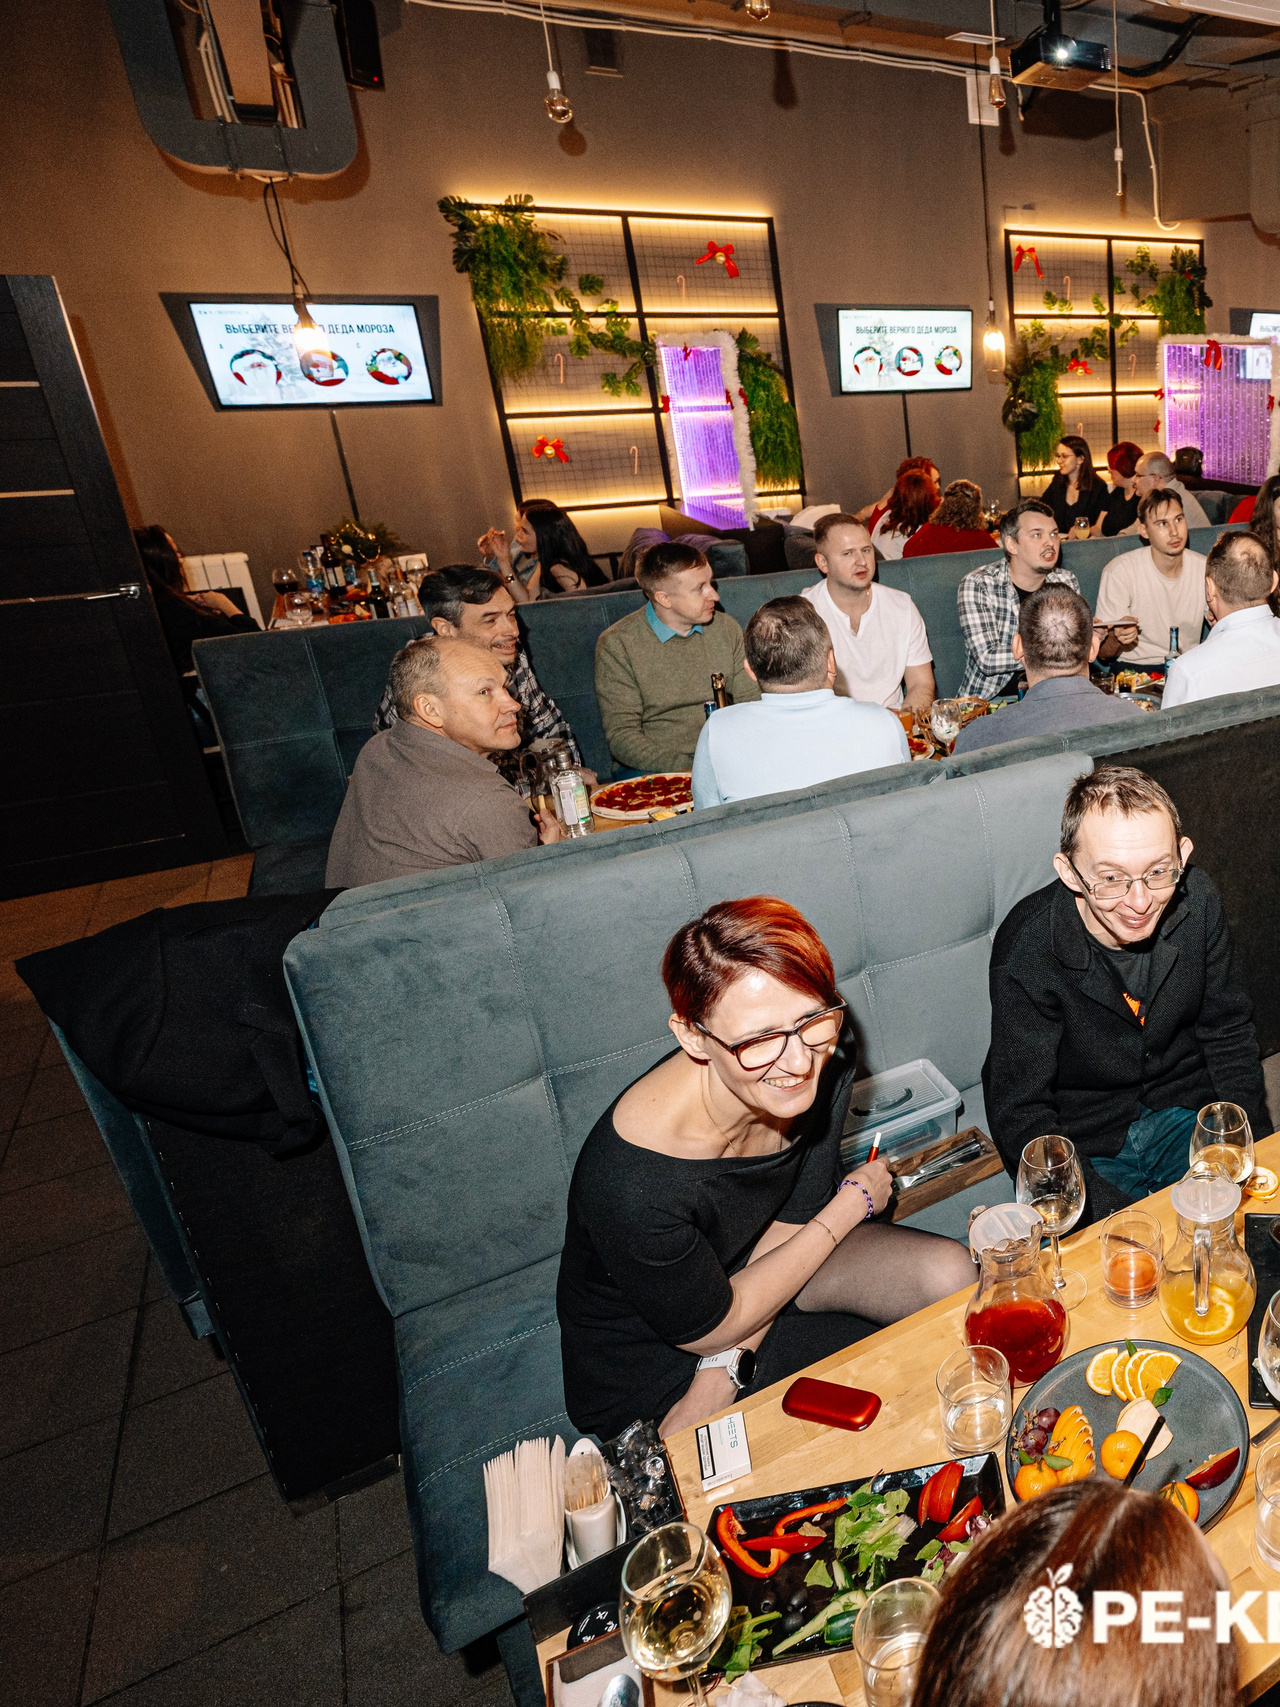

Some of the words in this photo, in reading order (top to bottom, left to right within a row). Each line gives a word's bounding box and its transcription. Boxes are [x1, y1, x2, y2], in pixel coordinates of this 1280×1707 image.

[224, 323, 280, 335] ВЫБЕРИТЕ
[328, 324, 355, 335] ДЕДА
[356, 323, 396, 334] МОРОЗА
[855, 326, 888, 335] ВЫБЕРИТЕ
[889, 325, 916, 334] ВЕРНОГО
[917, 325, 933, 335] ДЕДА
[934, 326, 957, 334] МОРОЗА
[727, 1416, 738, 1449] HEETS
